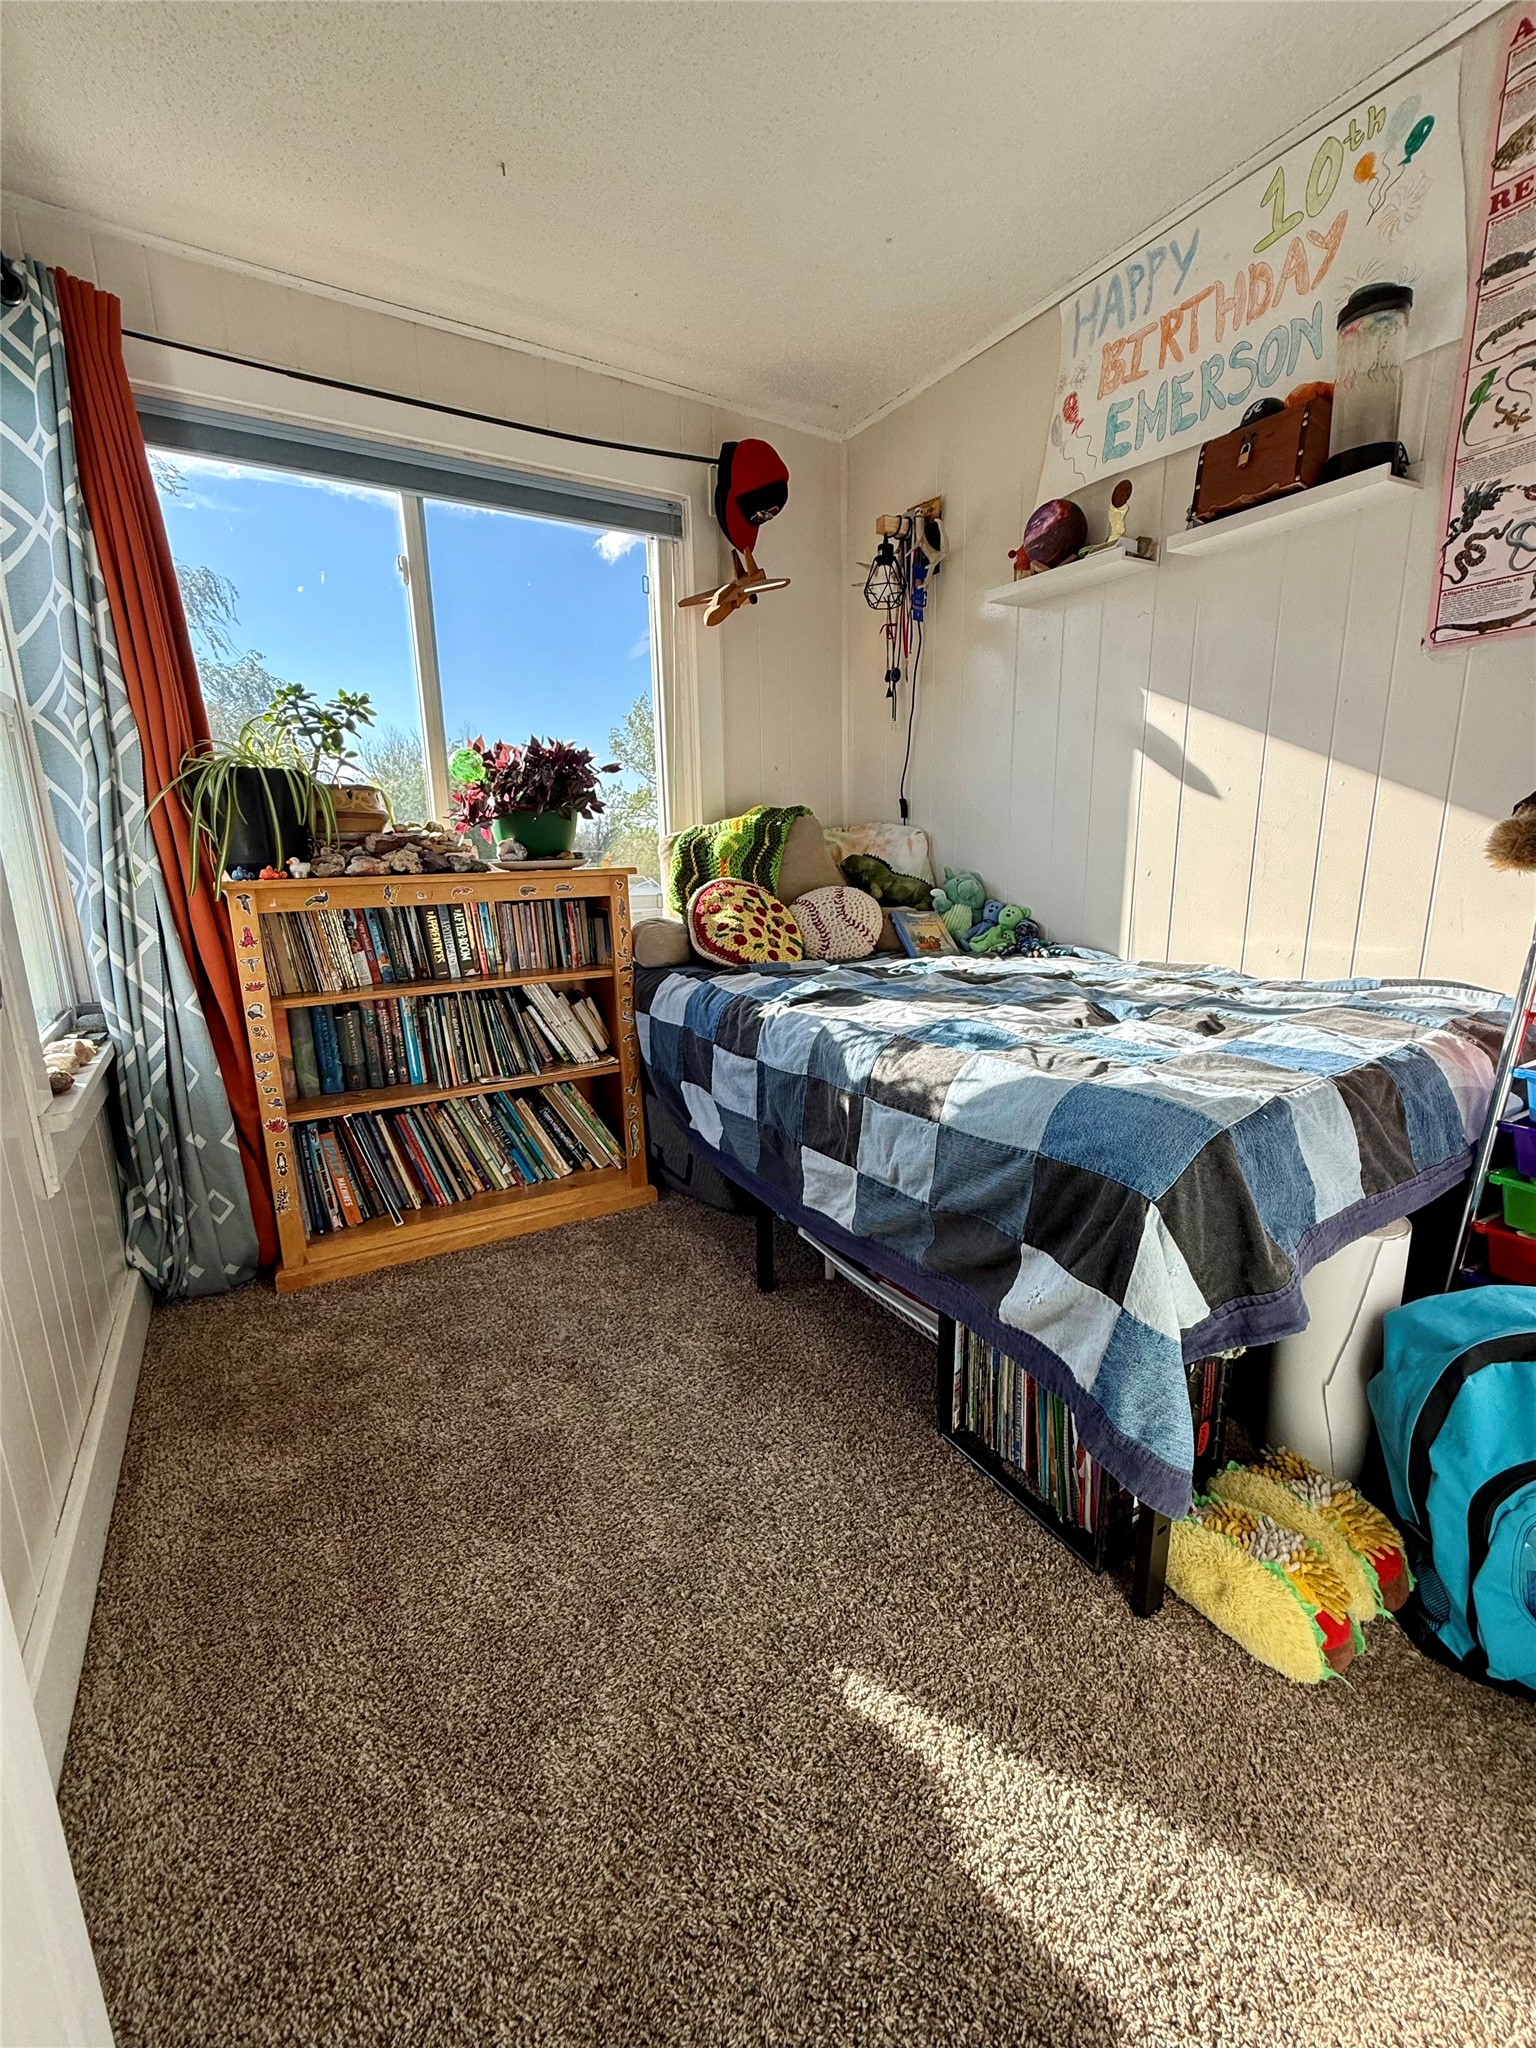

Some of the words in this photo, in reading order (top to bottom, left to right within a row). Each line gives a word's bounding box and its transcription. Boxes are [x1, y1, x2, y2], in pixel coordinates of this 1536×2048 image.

[1254, 106, 1387, 253] 10th
[1073, 228, 1200, 359] HAPPY
[1098, 210, 1348, 400] BIRTHDAY
[1103, 301, 1323, 463] EMERSON
[1442, 586, 1475, 598] Alligators,
[1476, 578, 1512, 591] Crocodiles,
[426, 914, 446, 963] APPRENTICES
[441, 920, 457, 965] APOTHECARY
[453, 911, 472, 961] AFTER-ROOM
[320, 1015, 329, 1040] HARRY
[346, 1013, 355, 1038] HARRY
[381, 1009, 390, 1033] HARRY
[324, 1042, 333, 1068] POTTER
[350, 1040, 359, 1065] POTTER
[385, 1035, 394, 1060] POTTER
[492, 1119, 507, 1138] WHAT
[322, 1138, 344, 1177] SPACE
[336, 1176, 354, 1208] MACHINES
